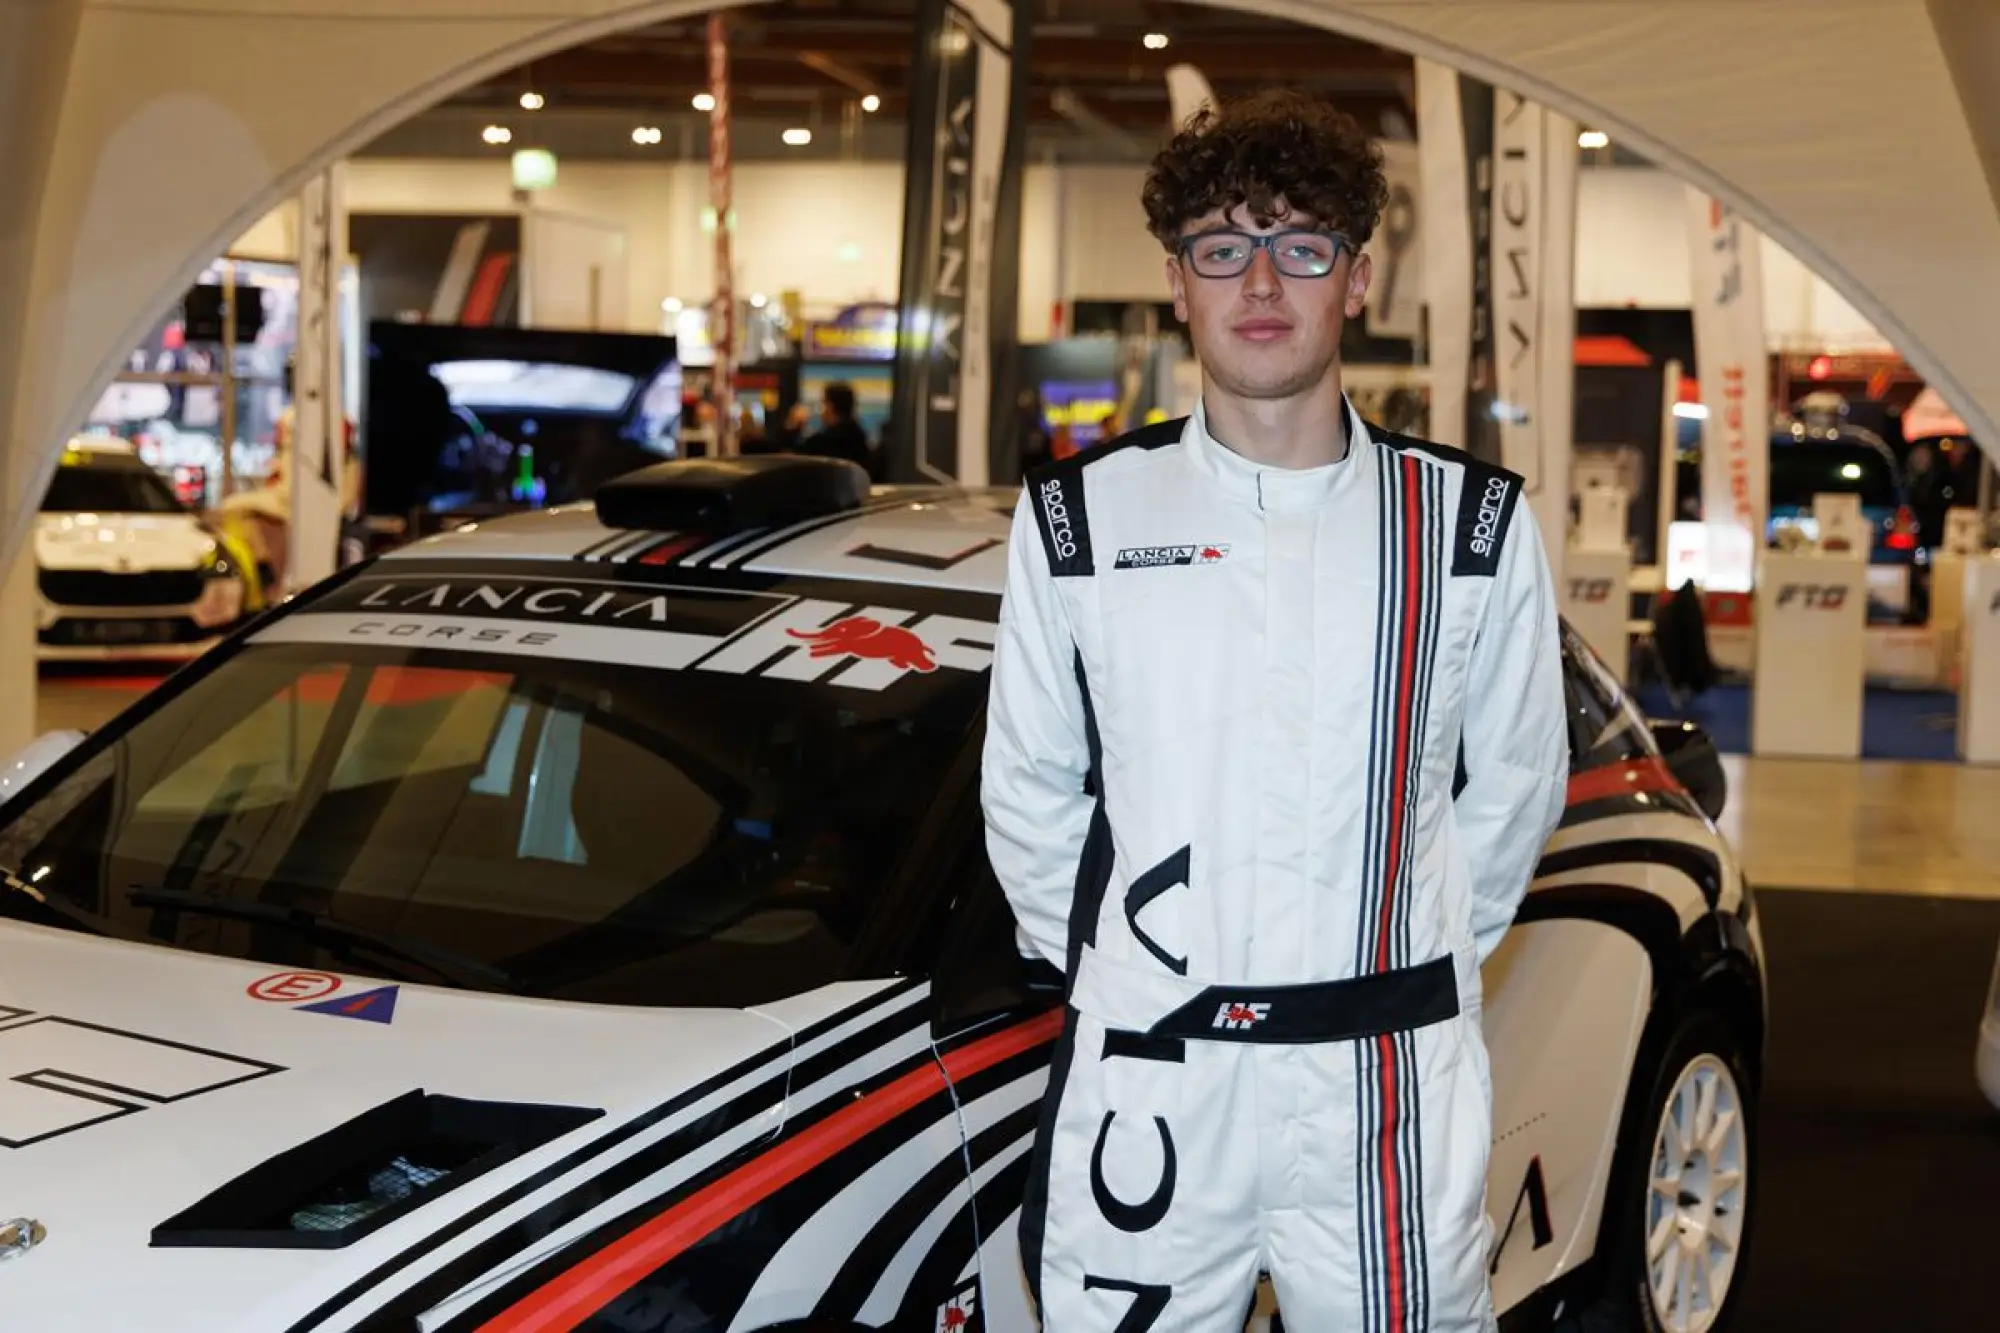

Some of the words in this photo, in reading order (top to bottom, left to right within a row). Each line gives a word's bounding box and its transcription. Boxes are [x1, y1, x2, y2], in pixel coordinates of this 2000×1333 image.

[1040, 478, 1077, 561] sparco
[1470, 477, 1510, 557] sparco
[1121, 548, 1186, 560] LANCIA
[360, 583, 667, 622] LANCIA
[350, 621, 558, 646] CORSE
[1212, 1002, 1272, 1030] HF
